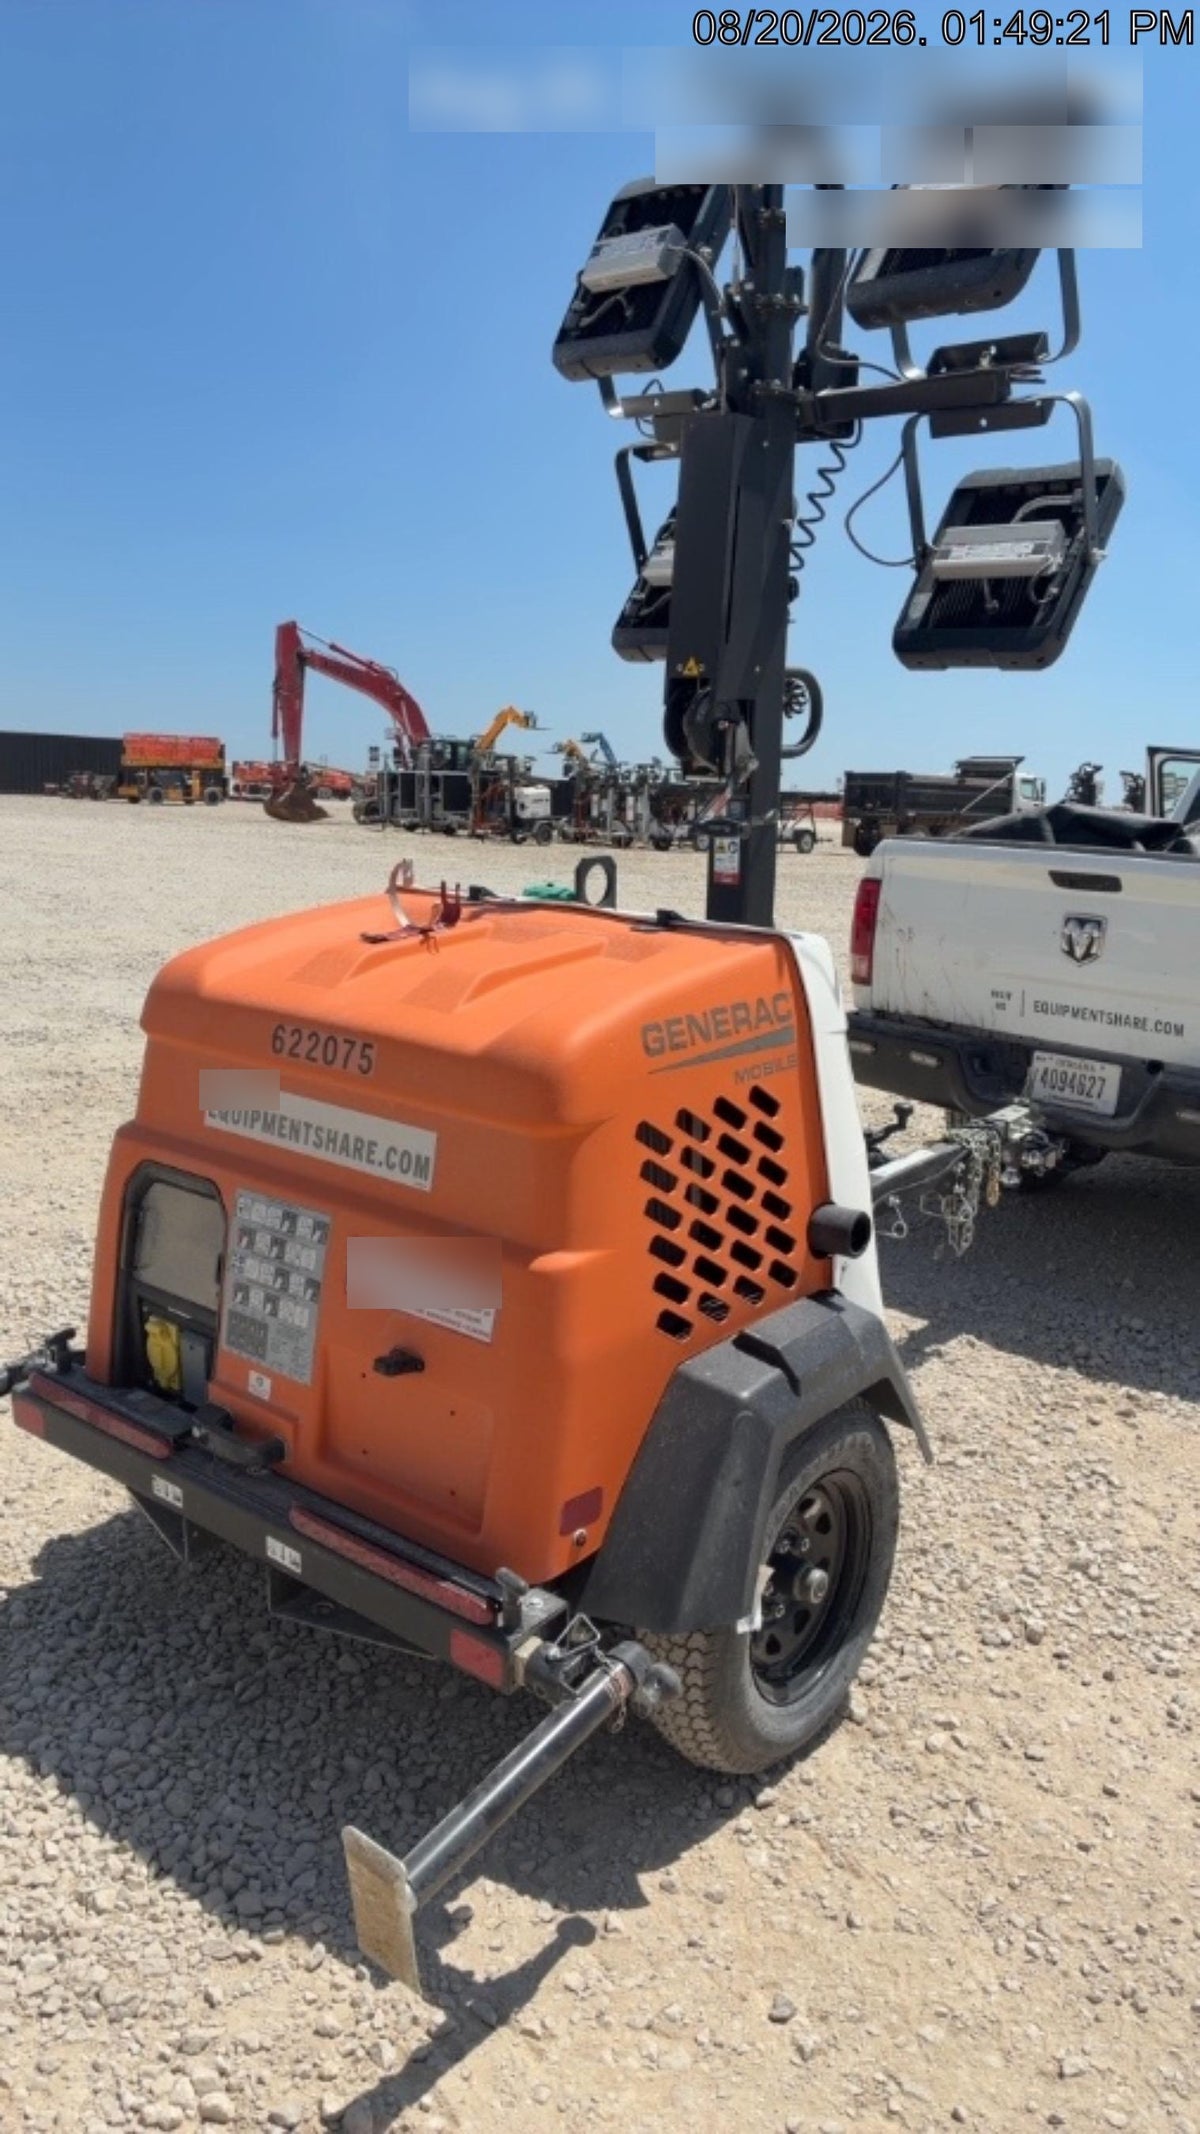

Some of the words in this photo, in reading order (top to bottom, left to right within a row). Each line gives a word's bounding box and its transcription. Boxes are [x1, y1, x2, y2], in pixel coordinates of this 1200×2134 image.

[641, 992, 793, 1058] GENERAC
[1033, 1000, 1185, 1037] EQUIPMENTSHARE.COM
[271, 1024, 374, 1075] 622075
